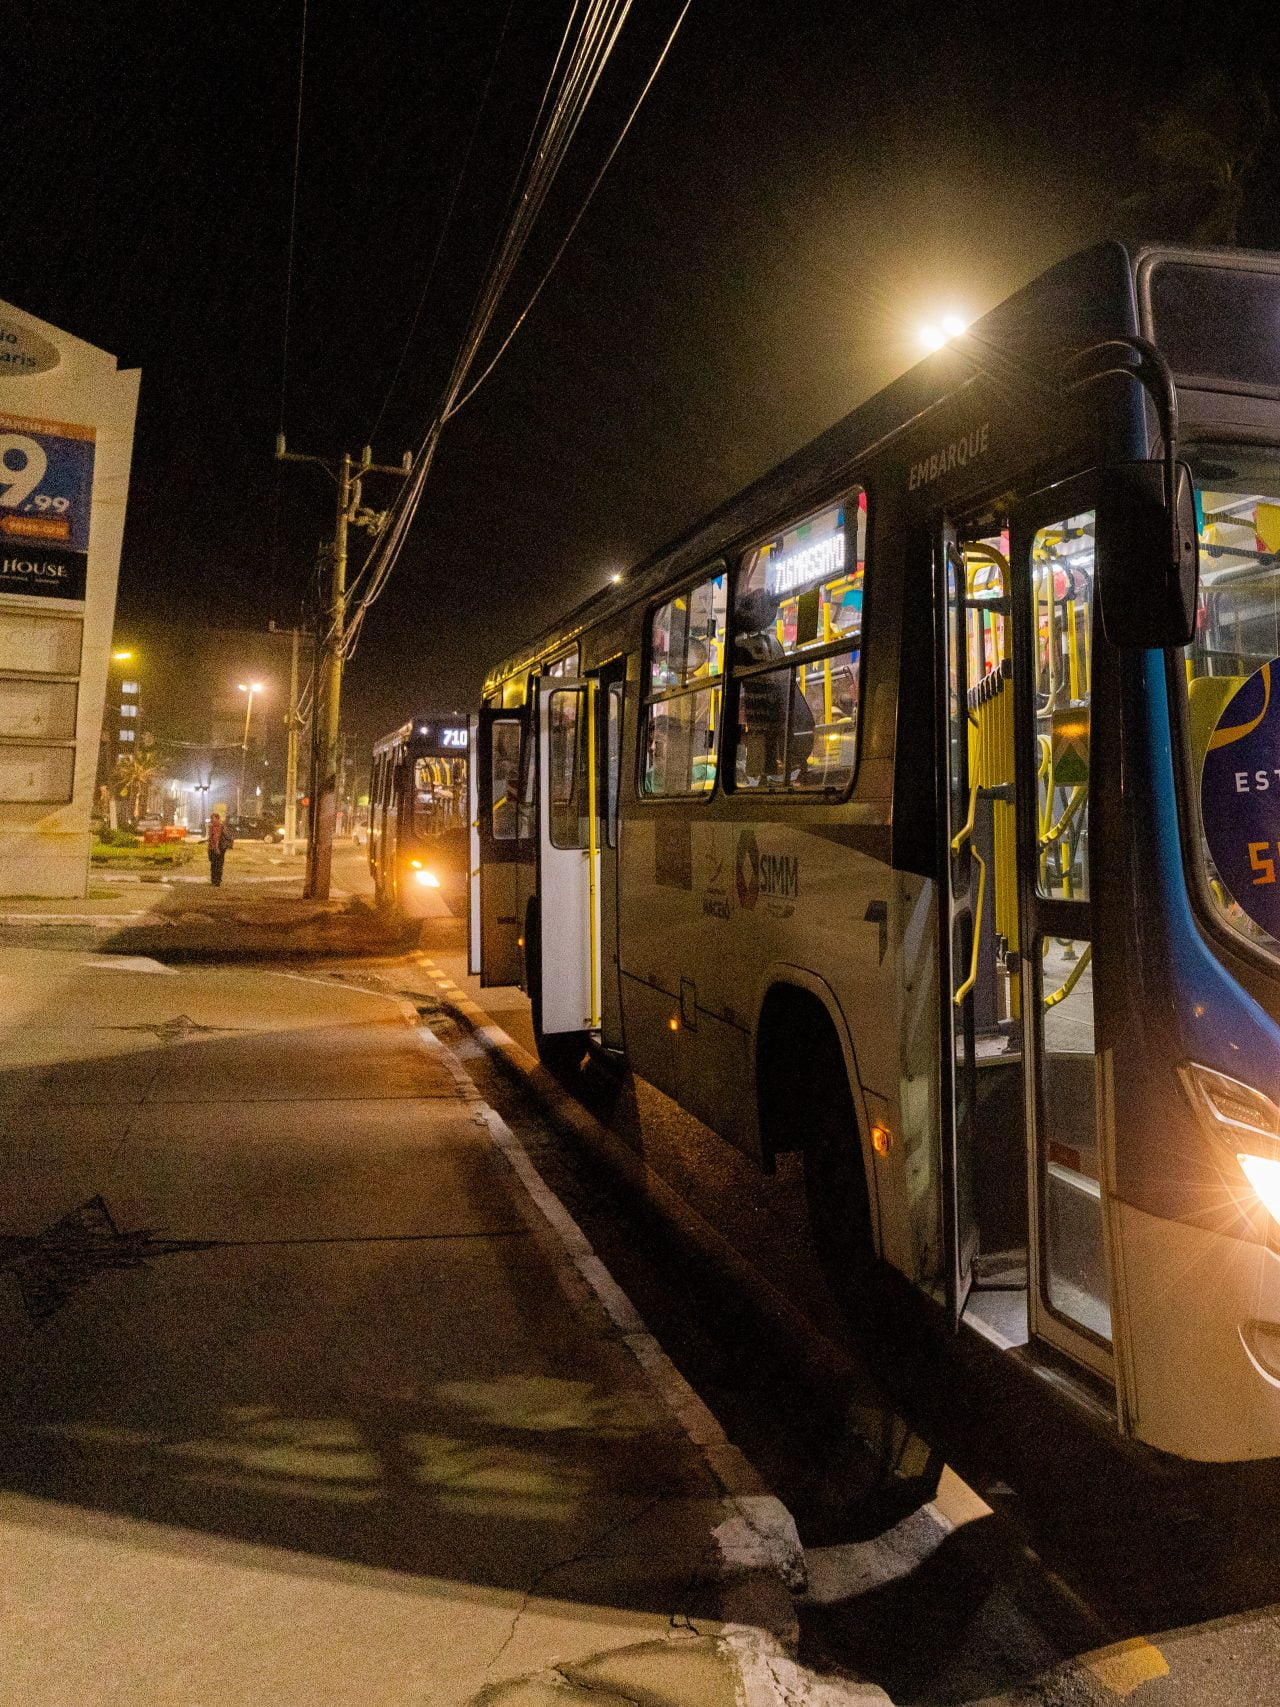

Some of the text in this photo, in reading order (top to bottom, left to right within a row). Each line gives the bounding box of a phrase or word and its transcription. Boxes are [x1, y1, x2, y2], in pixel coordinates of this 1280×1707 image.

[908, 423, 990, 491] EMBARQUE
[3, 558, 68, 577] HOUSE
[759, 853, 799, 898] SIMM
